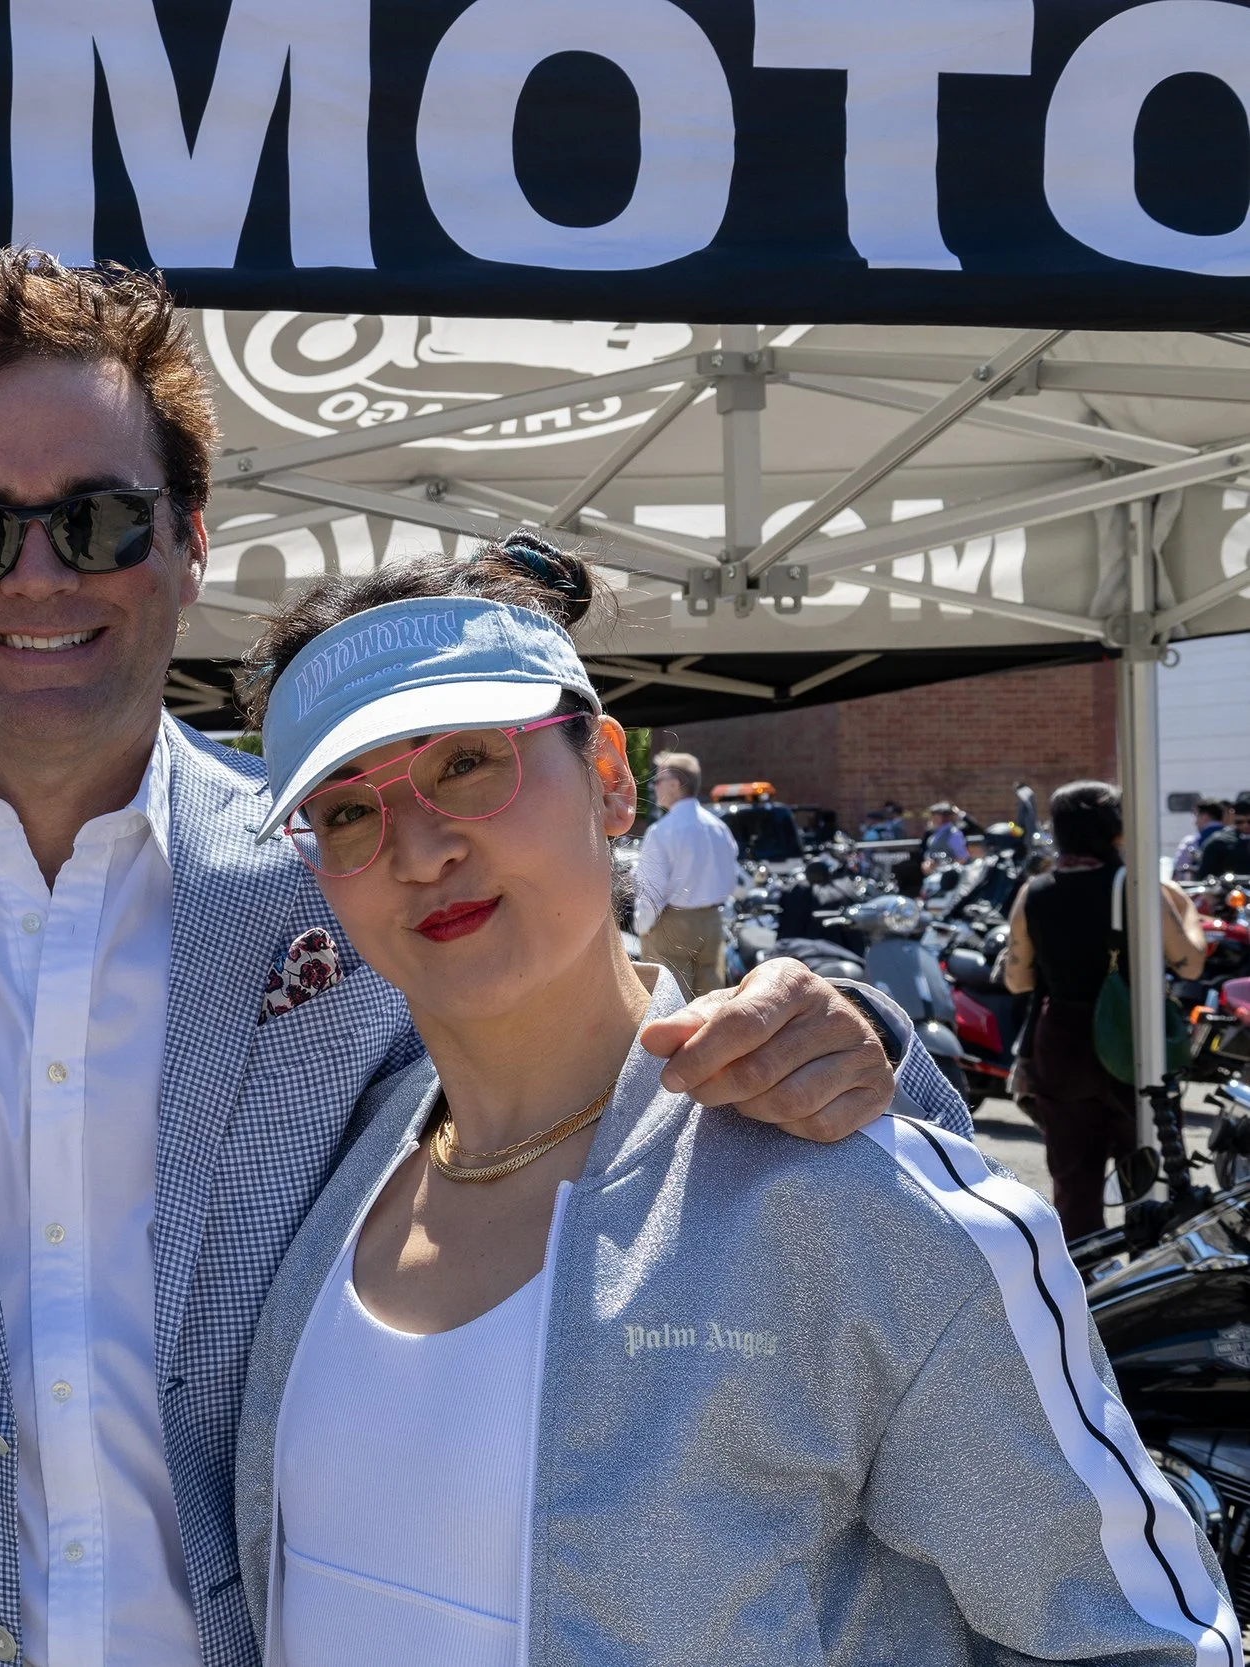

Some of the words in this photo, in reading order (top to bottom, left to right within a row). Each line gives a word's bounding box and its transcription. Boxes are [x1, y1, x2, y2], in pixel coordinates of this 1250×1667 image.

[294, 610, 462, 722] MOTOWORKS
[343, 661, 404, 692] CHICAGO
[624, 1323, 696, 1358] Palm
[705, 1321, 778, 1359] Angels
